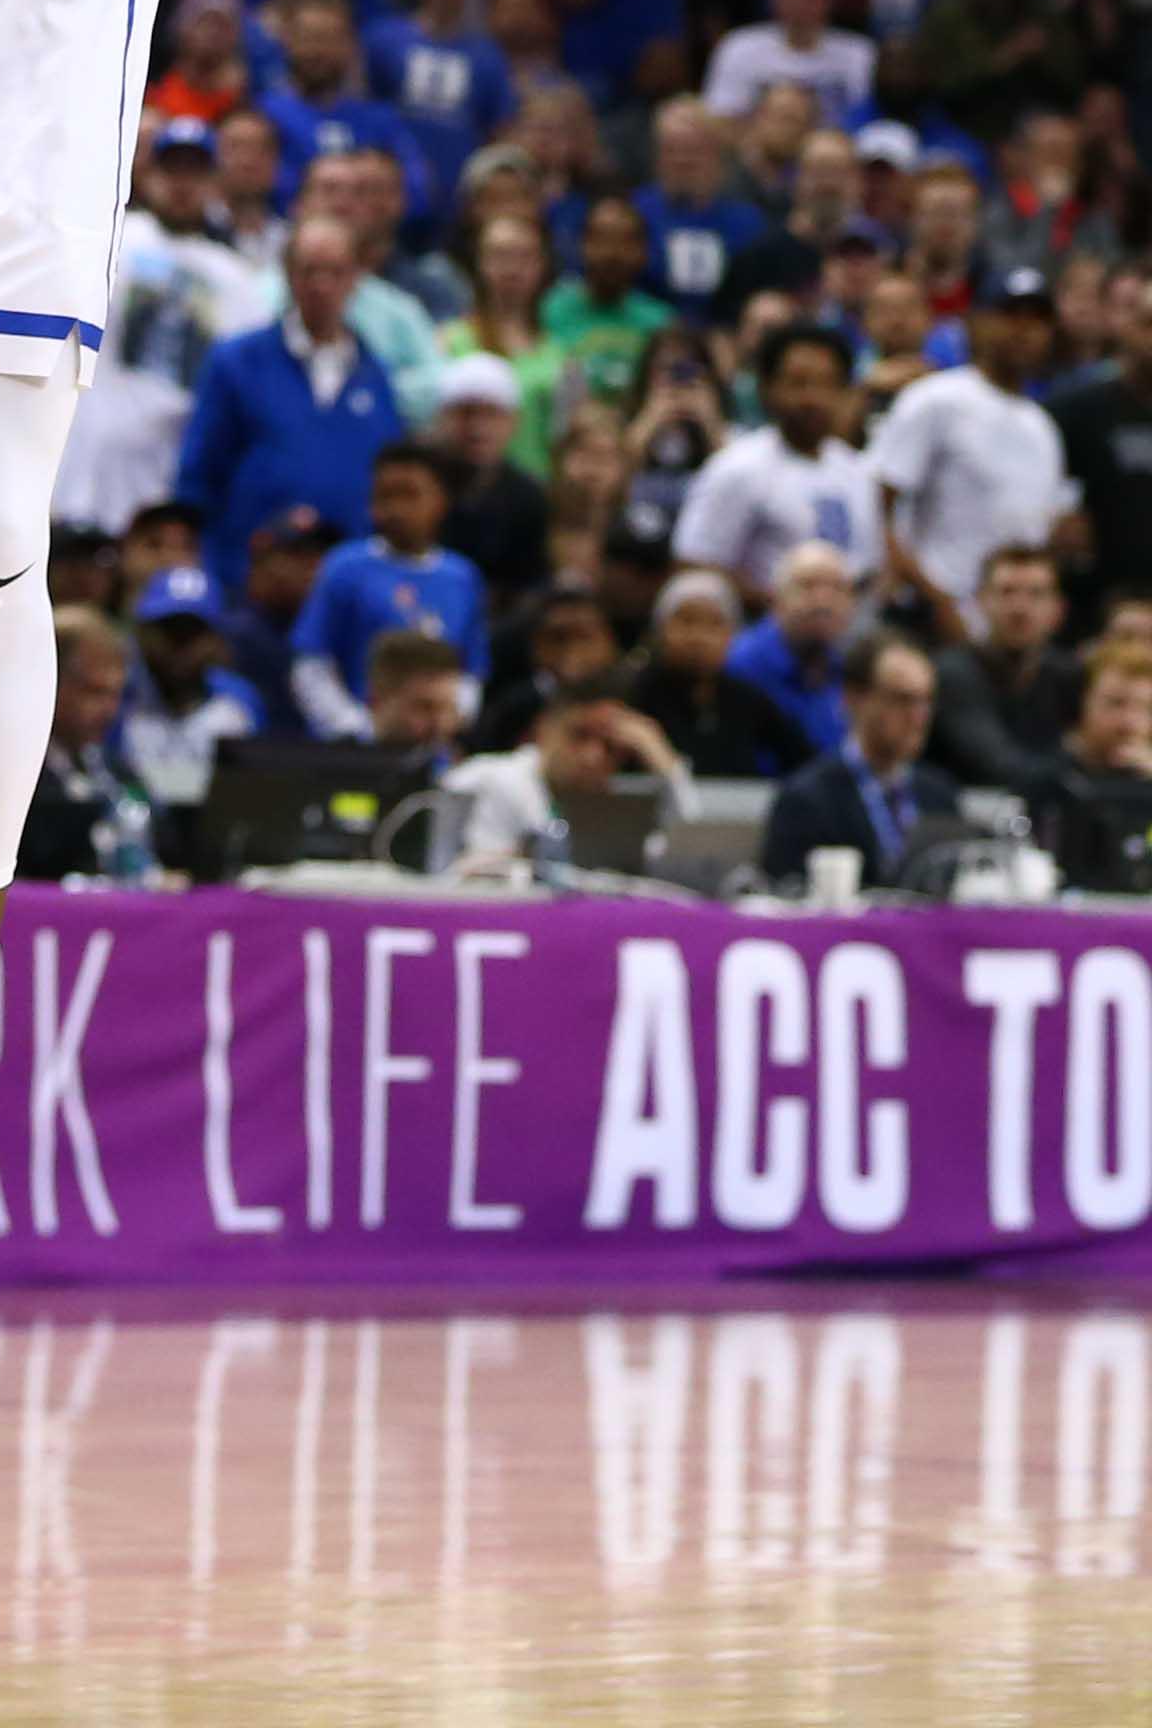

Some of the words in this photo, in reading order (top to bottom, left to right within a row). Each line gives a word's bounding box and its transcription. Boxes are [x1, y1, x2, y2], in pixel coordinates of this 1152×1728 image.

[202, 927, 531, 1235] LIFE
[583, 936, 910, 1235] ACC
[961, 945, 1152, 1235] TO
